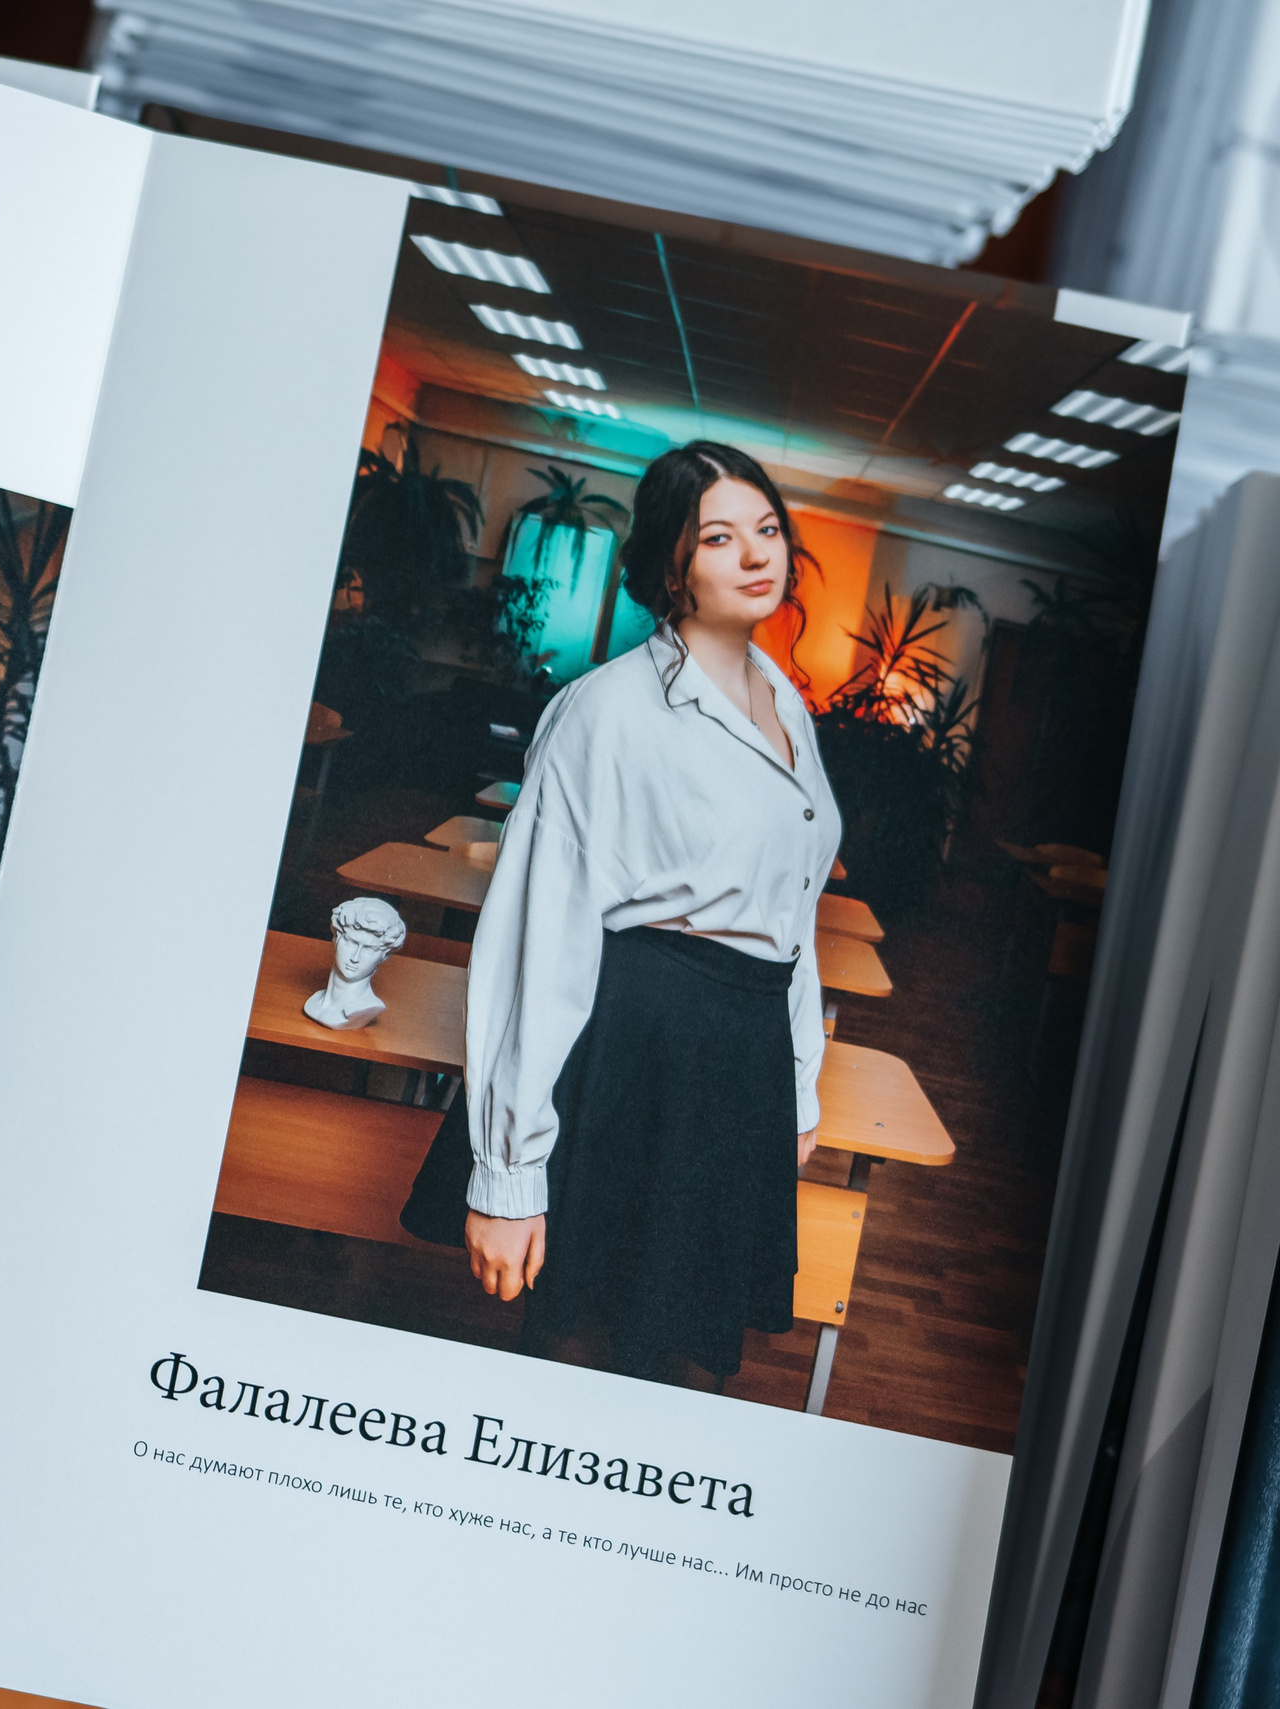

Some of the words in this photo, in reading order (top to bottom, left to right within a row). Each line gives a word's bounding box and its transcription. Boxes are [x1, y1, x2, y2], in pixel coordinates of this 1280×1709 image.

[149, 1351, 448, 1456] Фалалеева
[463, 1413, 755, 1519] Елизавета
[133, 1440, 148, 1458] О
[153, 1447, 186, 1466] нас
[188, 1456, 265, 1482] думают
[267, 1471, 323, 1494] плохо
[326, 1484, 378, 1505] лишь
[383, 1494, 408, 1515] те,
[413, 1500, 444, 1518] кто
[448, 1507, 494, 1529] хуже
[499, 1518, 536, 1540] нас,
[541, 1527, 552, 1541] а
[558, 1529, 578, 1545] те
[582, 1535, 613, 1552] кто
[616, 1542, 677, 1565] лучше
[735, 1561, 764, 1584] Им
[769, 1572, 834, 1597] просто
[838, 1586, 862, 1603] не
[864, 1593, 890, 1611] до
[895, 1598, 928, 1616] нас
